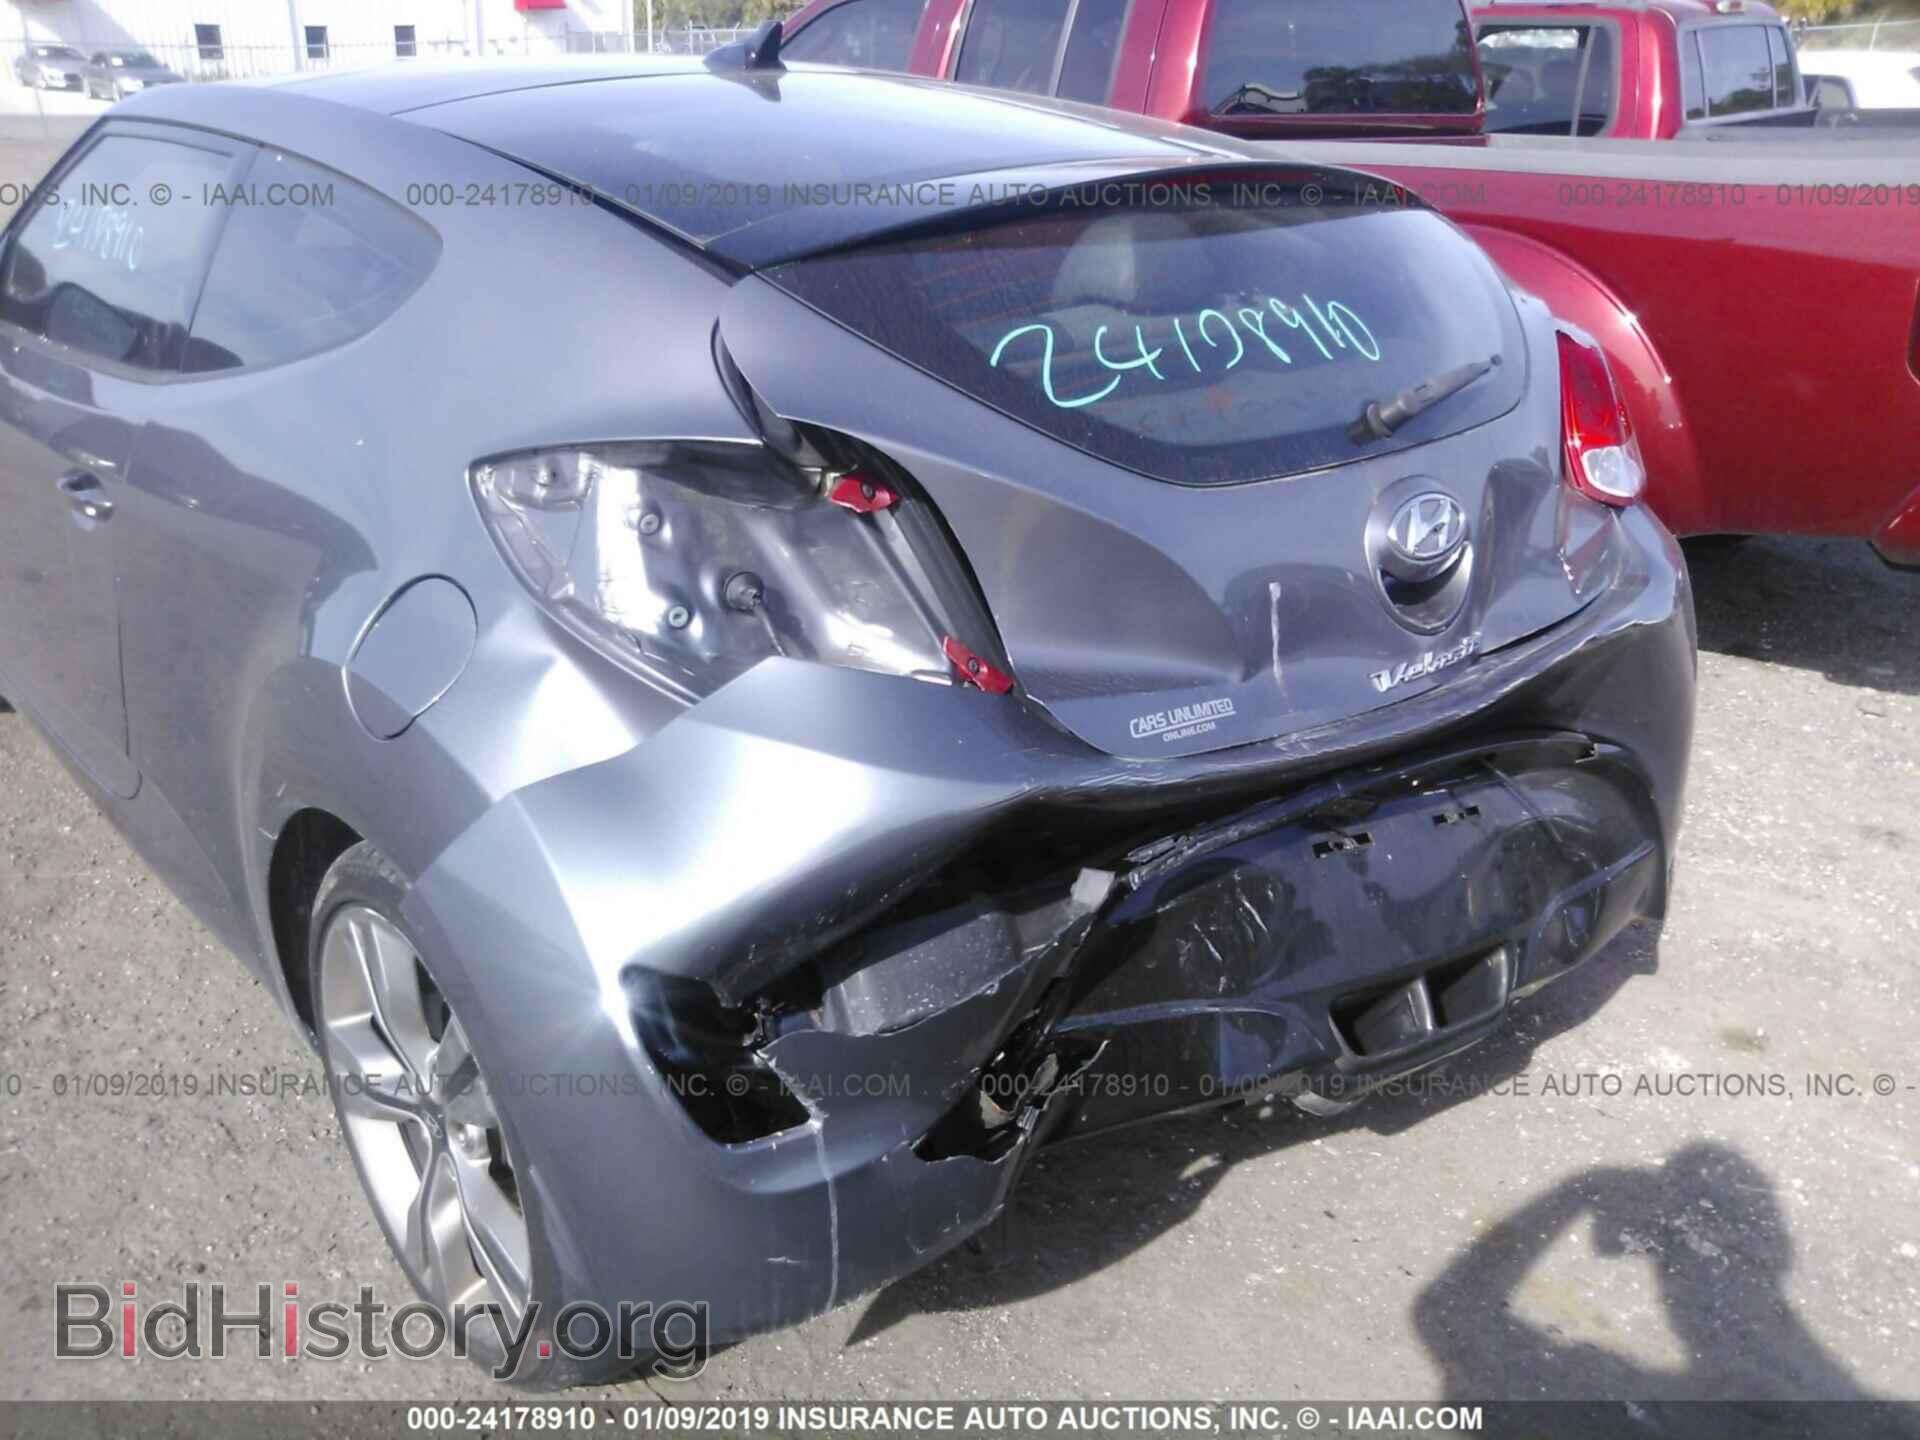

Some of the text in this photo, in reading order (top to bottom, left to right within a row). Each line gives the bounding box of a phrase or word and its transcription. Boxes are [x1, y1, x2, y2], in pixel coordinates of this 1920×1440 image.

[1129, 697, 1234, 738] CARS UNLIMITED
[1161, 721, 1217, 742] ONLINE.COM
